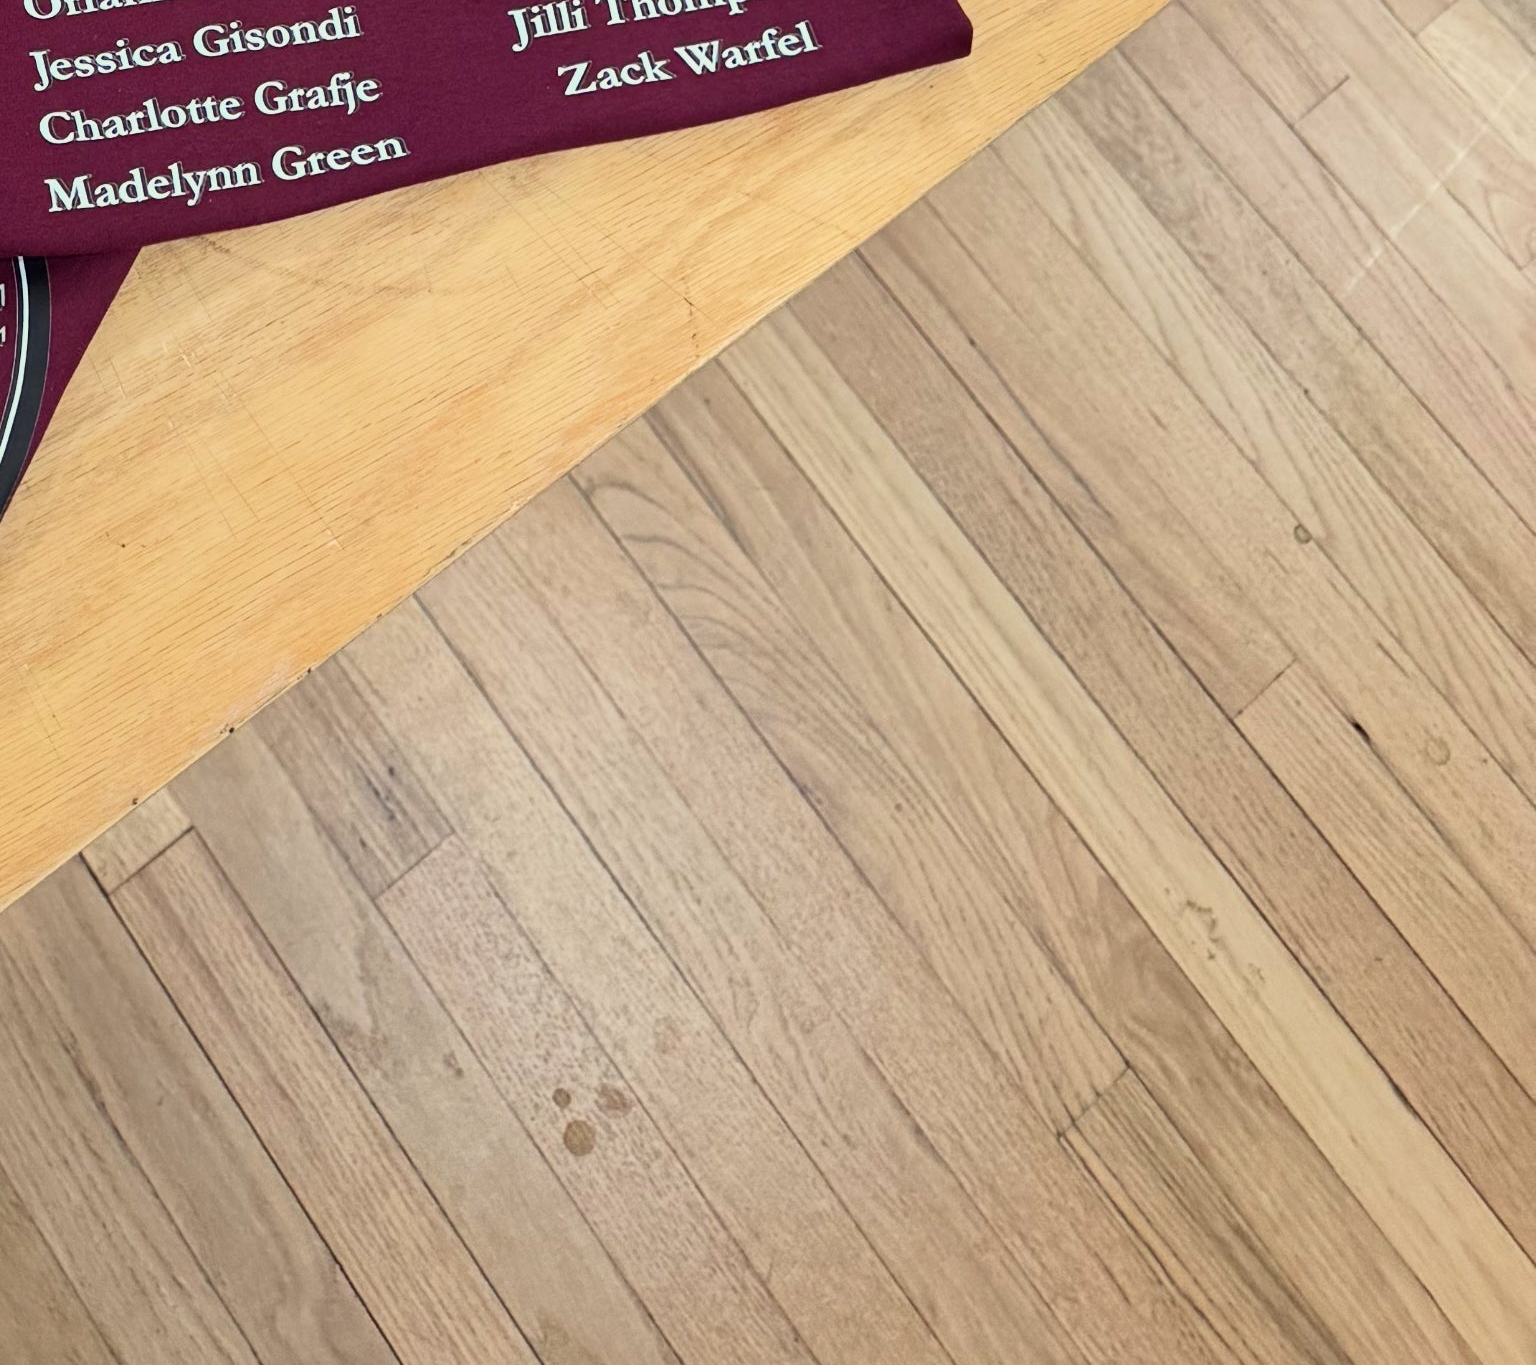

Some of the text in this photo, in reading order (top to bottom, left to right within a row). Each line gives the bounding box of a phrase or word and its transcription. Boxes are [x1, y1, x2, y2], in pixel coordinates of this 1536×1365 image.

[28, 5, 364, 91] Jessica Gisondi
[558, 20, 822, 96] Zack Warfel
[38, 71, 383, 145] Charlotte Grafje
[44, 135, 411, 212] Madelynn Green
